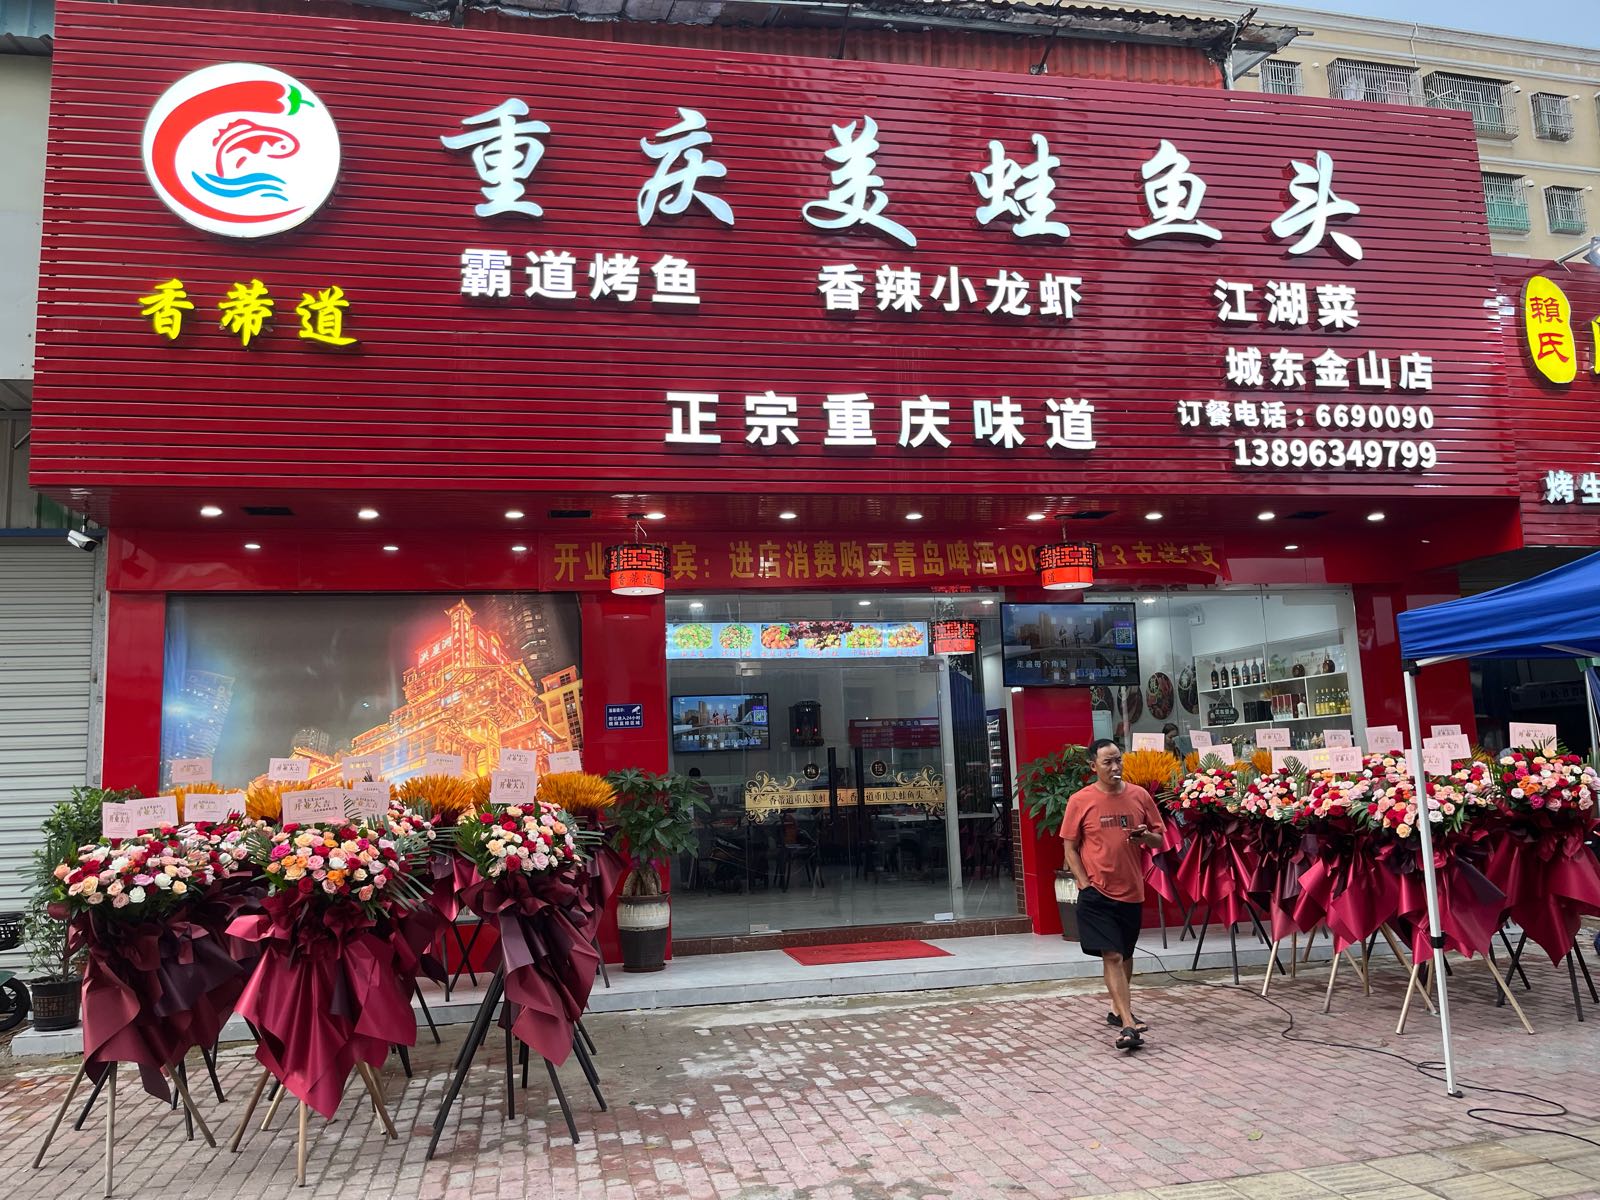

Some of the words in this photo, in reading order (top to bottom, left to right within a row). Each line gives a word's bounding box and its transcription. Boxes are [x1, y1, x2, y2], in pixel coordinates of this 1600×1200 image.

[440, 97, 1364, 261] 重庆美蛙鱼头
[461, 249, 700, 304] 霸道烤鱼
[818, 264, 1082, 319] 香辣小龙虾
[1214, 279, 1360, 328] 江湖菜
[139, 278, 357, 346] 香蒂道
[1226, 347, 1433, 390] 城东金山店
[665, 391, 1097, 449] 正宗重庆味道
[1234, 439, 1437, 468] 13896349799
[768, 792, 844, 806] 香蒂道重庆美蛙头
[849, 789, 924, 802] 香道重庆美蛙鱼头
